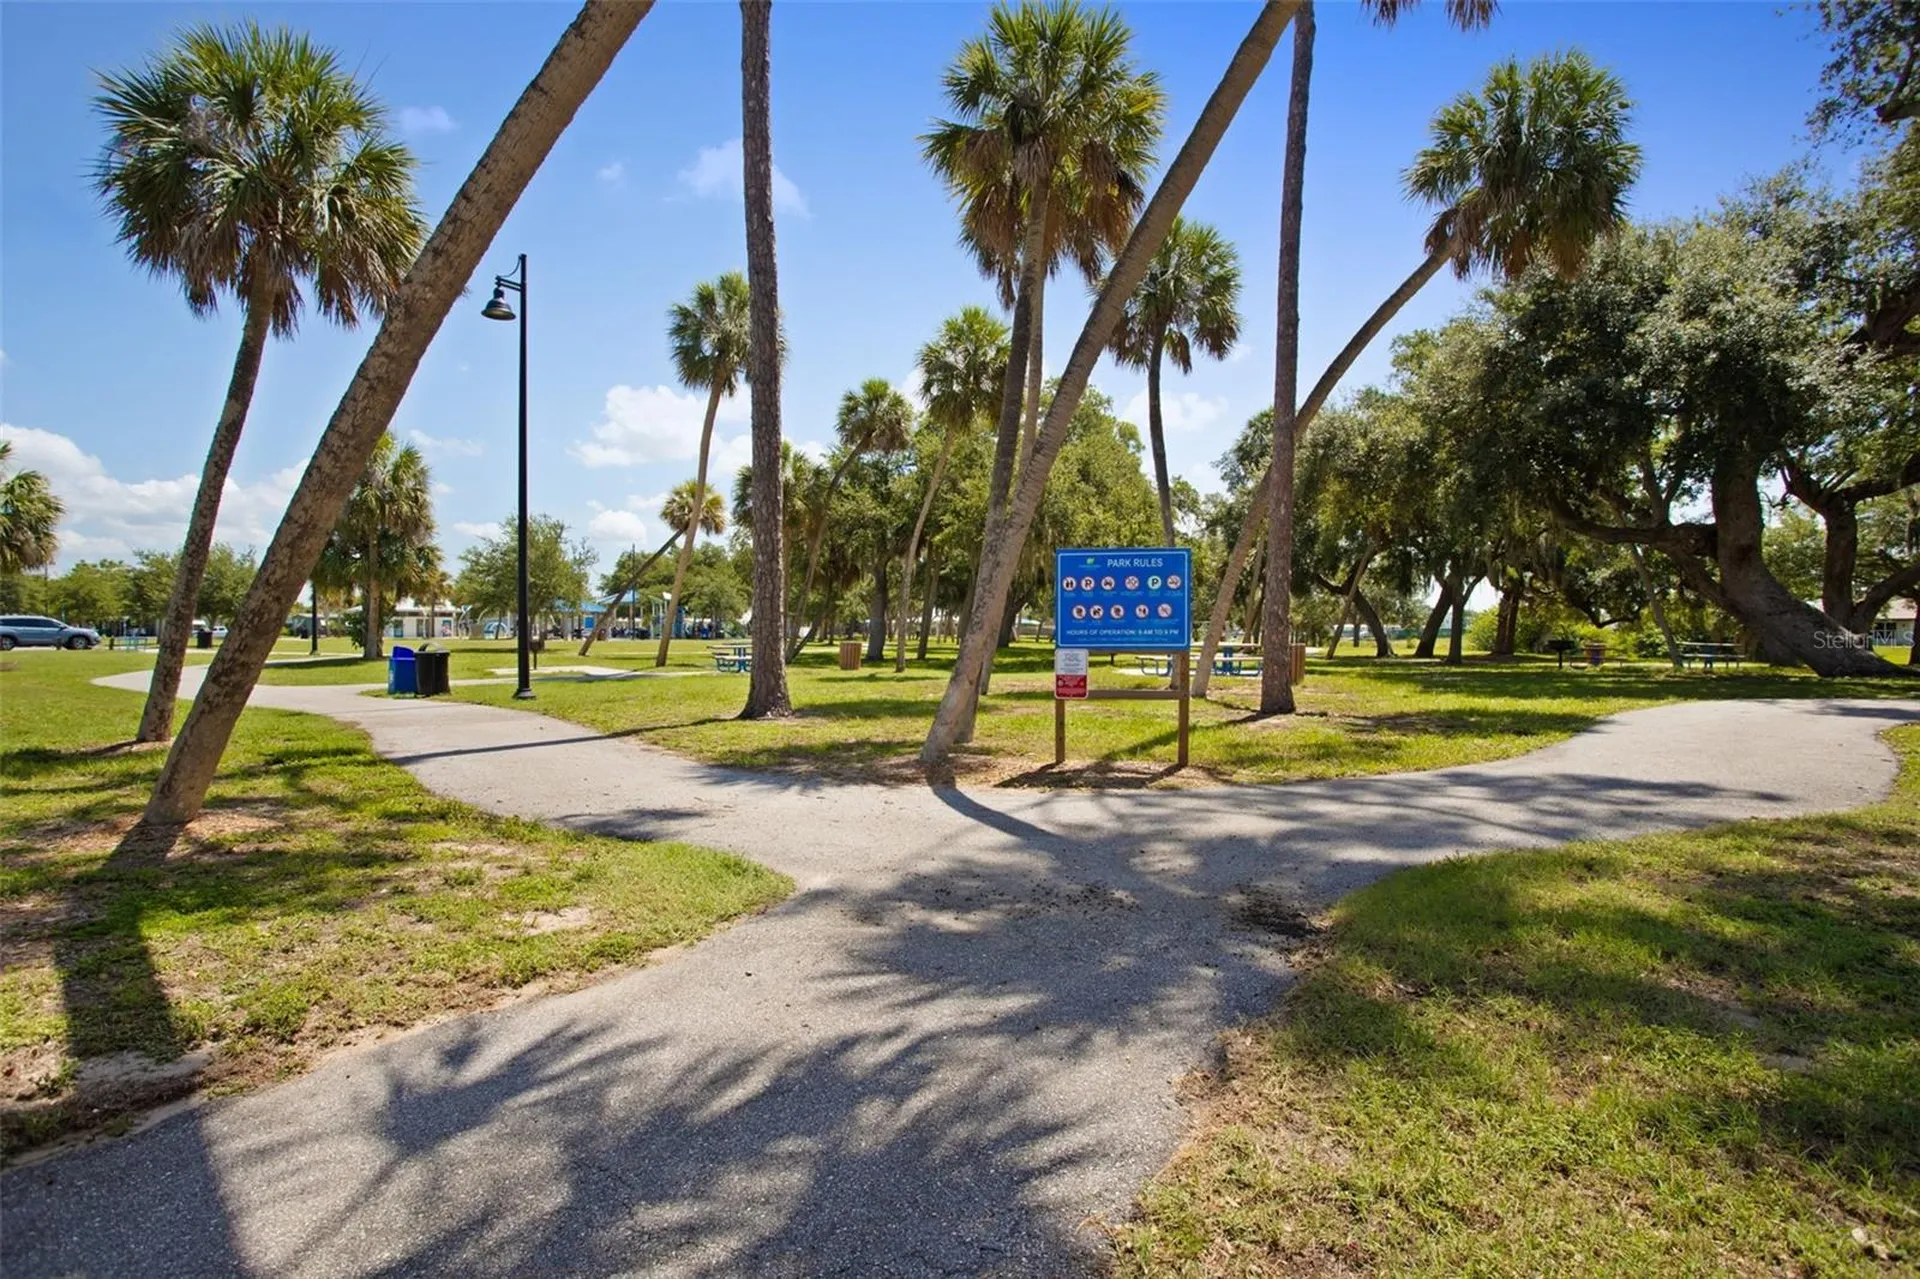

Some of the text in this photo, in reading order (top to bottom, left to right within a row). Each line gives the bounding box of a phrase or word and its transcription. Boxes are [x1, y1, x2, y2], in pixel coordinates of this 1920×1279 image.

[1107, 558, 1131, 567] PARK
[1133, 557, 1164, 567] RULES
[1066, 628, 1088, 636] HOURS
[1089, 628, 1098, 636] OF
